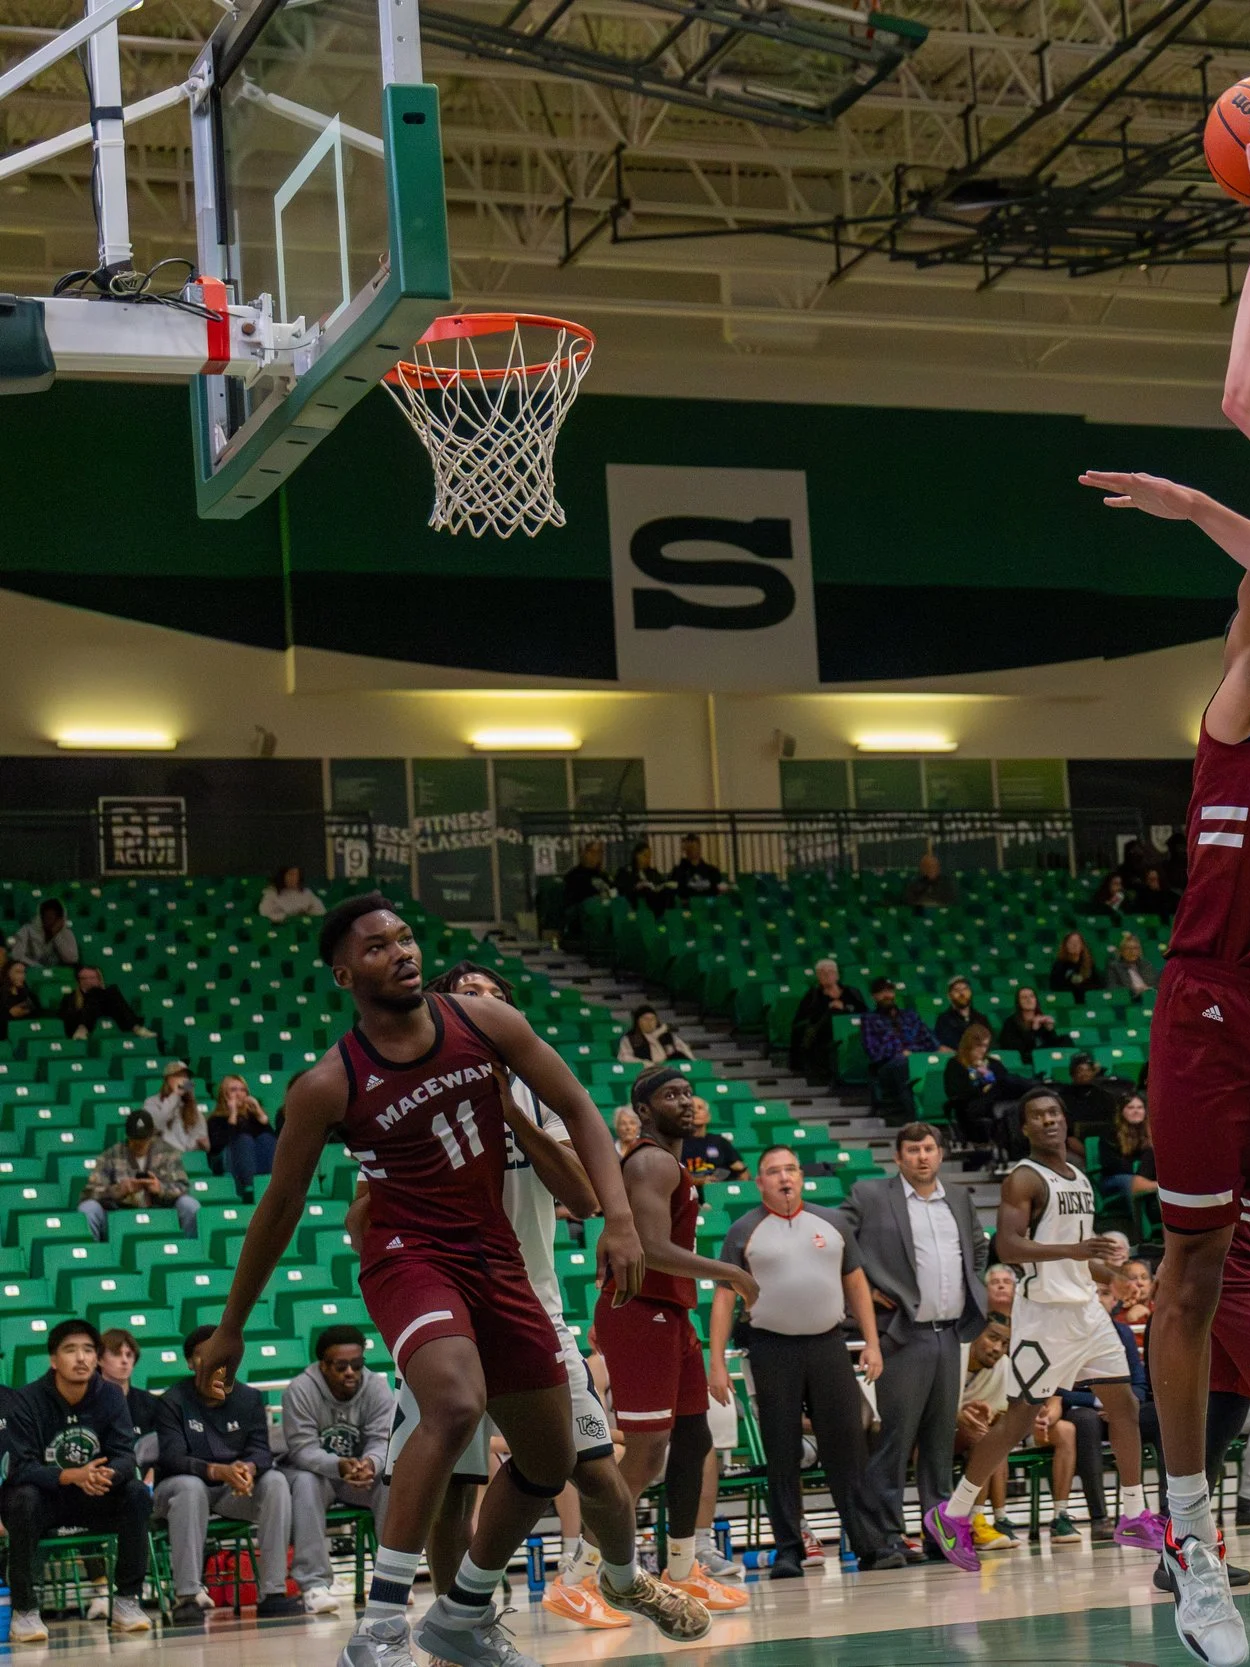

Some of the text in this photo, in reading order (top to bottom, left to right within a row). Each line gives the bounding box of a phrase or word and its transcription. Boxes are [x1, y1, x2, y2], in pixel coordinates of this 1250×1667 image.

[630, 515, 796, 630] S
[349, 848, 363, 869] 9
[376, 1062, 493, 1131] MACEWAN
[432, 1099, 485, 1170] 11
